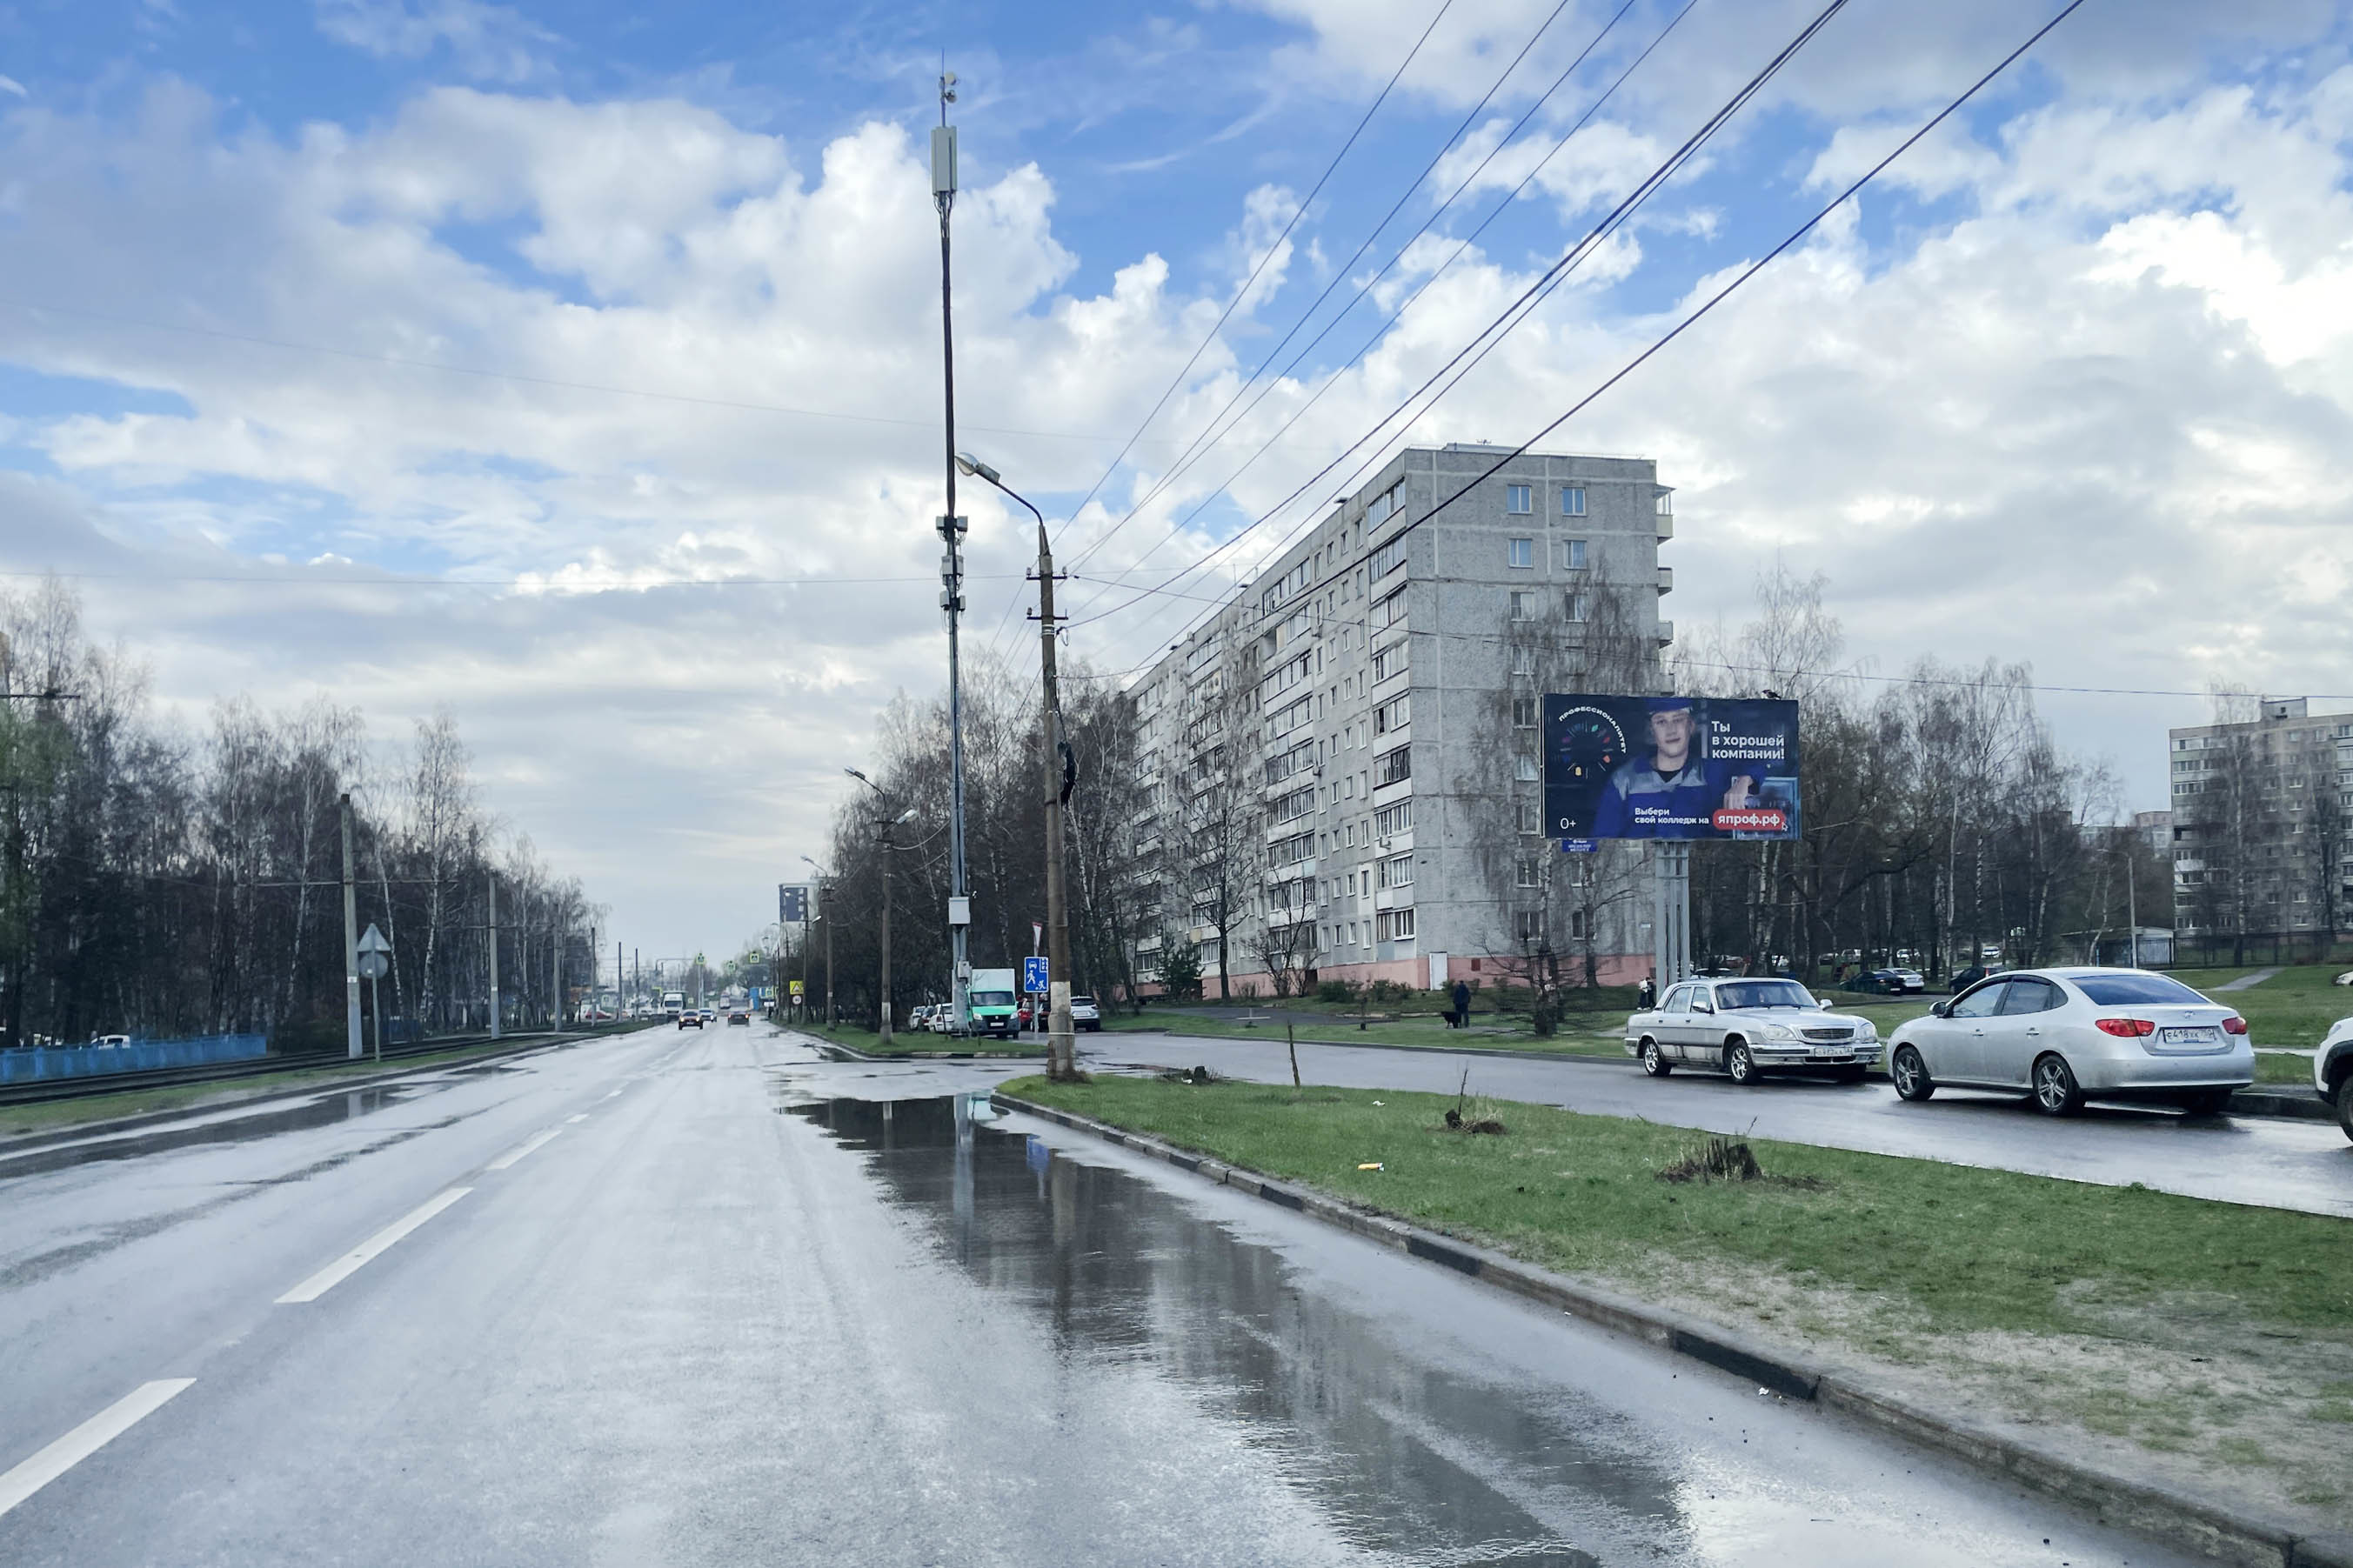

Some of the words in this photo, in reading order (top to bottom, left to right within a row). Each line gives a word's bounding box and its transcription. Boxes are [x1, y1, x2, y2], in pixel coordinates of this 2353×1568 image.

[1558, 706, 1627, 754] ПРОФЕССИОНАЛИТЕТ
[1711, 720, 1731, 732] Ты
[1712, 736, 1720, 745] в
[1722, 734, 1785, 748] хорошей
[1712, 748, 1785, 760] компании!
[1634, 807, 1670, 816] Выбери
[1560, 817, 1577, 830] 0+
[1634, 815, 1656, 824] свой
[1658, 816, 1697, 825] колледж
[1718, 813, 1781, 827] япроф.рф
